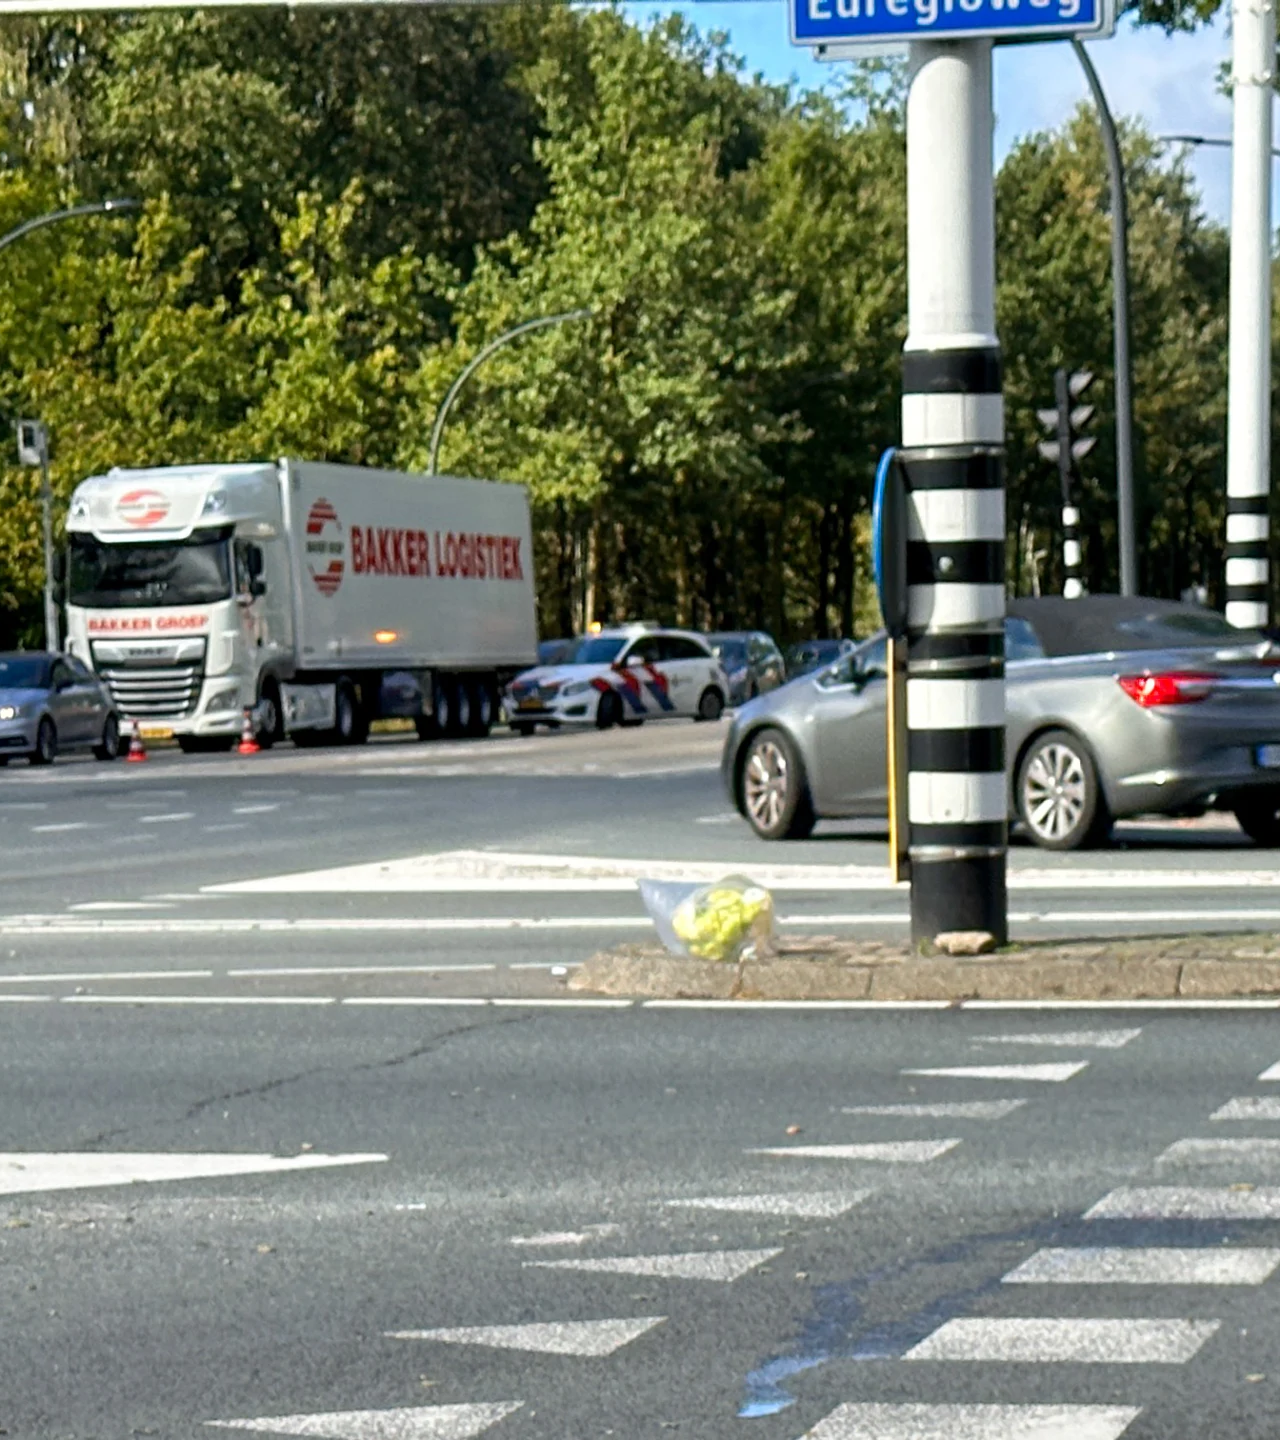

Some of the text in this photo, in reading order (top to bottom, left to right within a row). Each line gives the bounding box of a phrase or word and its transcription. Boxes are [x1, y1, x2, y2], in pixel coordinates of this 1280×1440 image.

[350, 525, 524, 580] BAKKER LOGISTIEK
[88, 617, 152, 631] BAKKER
